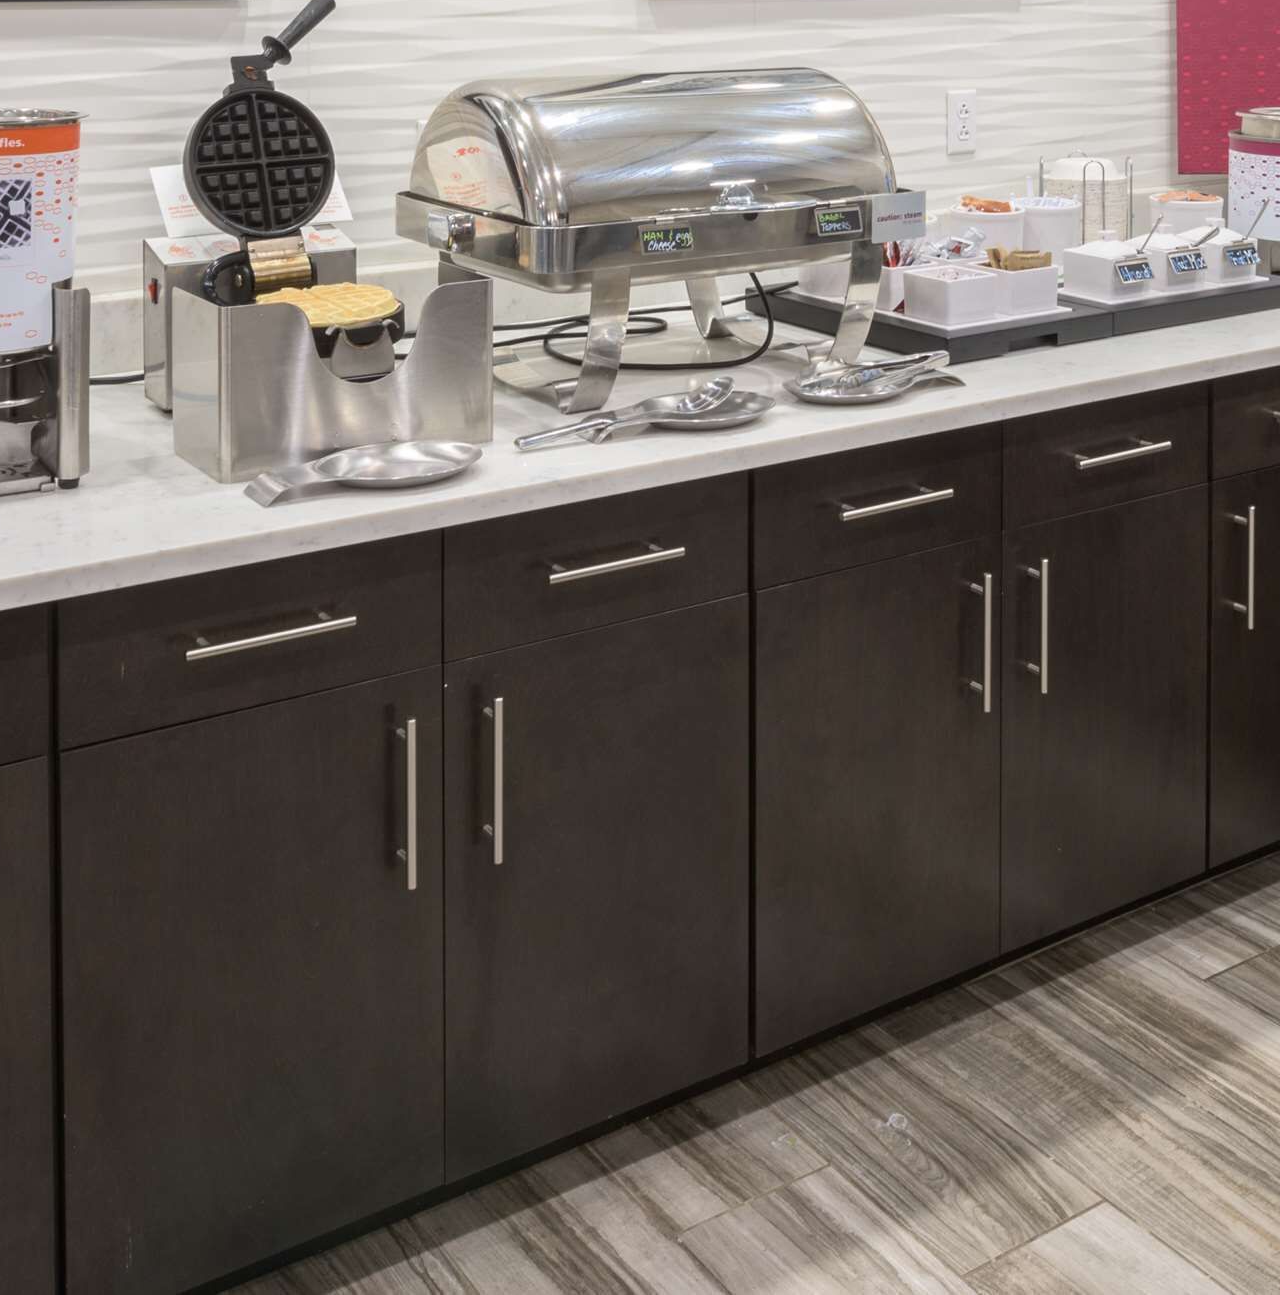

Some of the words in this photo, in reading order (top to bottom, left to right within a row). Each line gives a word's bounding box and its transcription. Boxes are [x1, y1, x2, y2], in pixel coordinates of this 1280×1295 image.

[877, 214, 902, 223] caution:
[903, 211, 923, 219] steam
[643, 231, 664, 242] HAM
